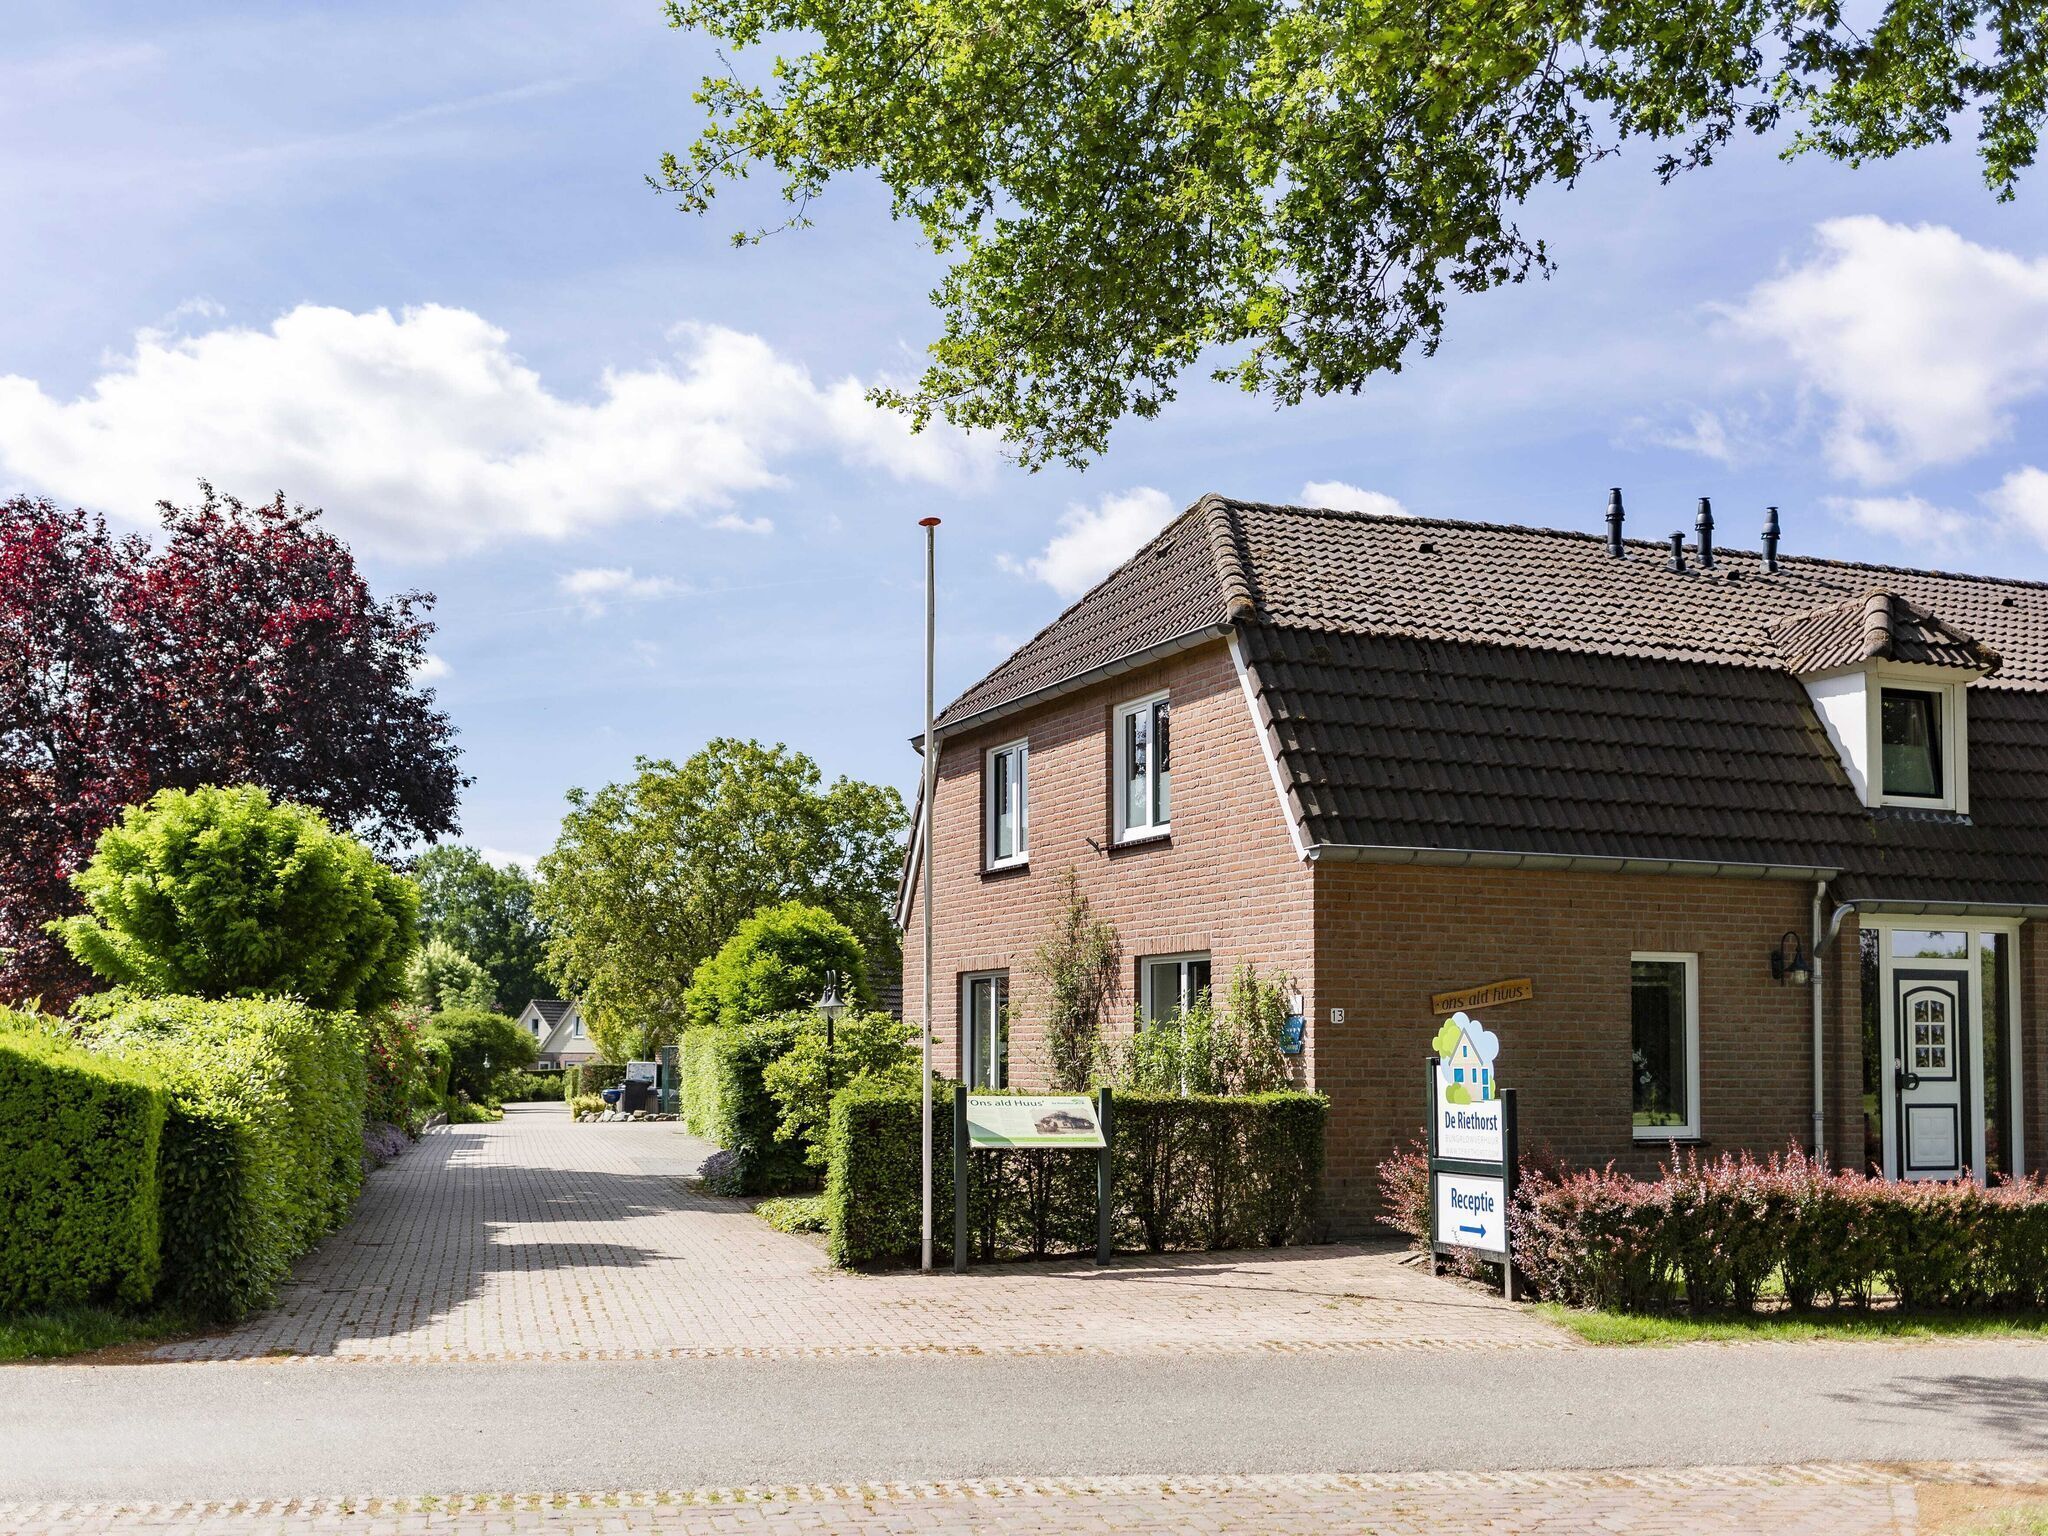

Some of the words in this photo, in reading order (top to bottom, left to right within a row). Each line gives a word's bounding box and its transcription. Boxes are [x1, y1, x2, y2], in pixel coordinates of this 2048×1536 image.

[1441, 997, 1464, 1010] ons
[1468, 989, 1489, 1005] ald
[1493, 986, 1523, 1002] huus
[1332, 1010, 1343, 1022] 13
[995, 1099, 1011, 1107] ald
[1445, 1111, 1456, 1129] De
[1457, 1111, 1498, 1131] Riethorst
[1451, 1187, 1494, 1216] Receptie
